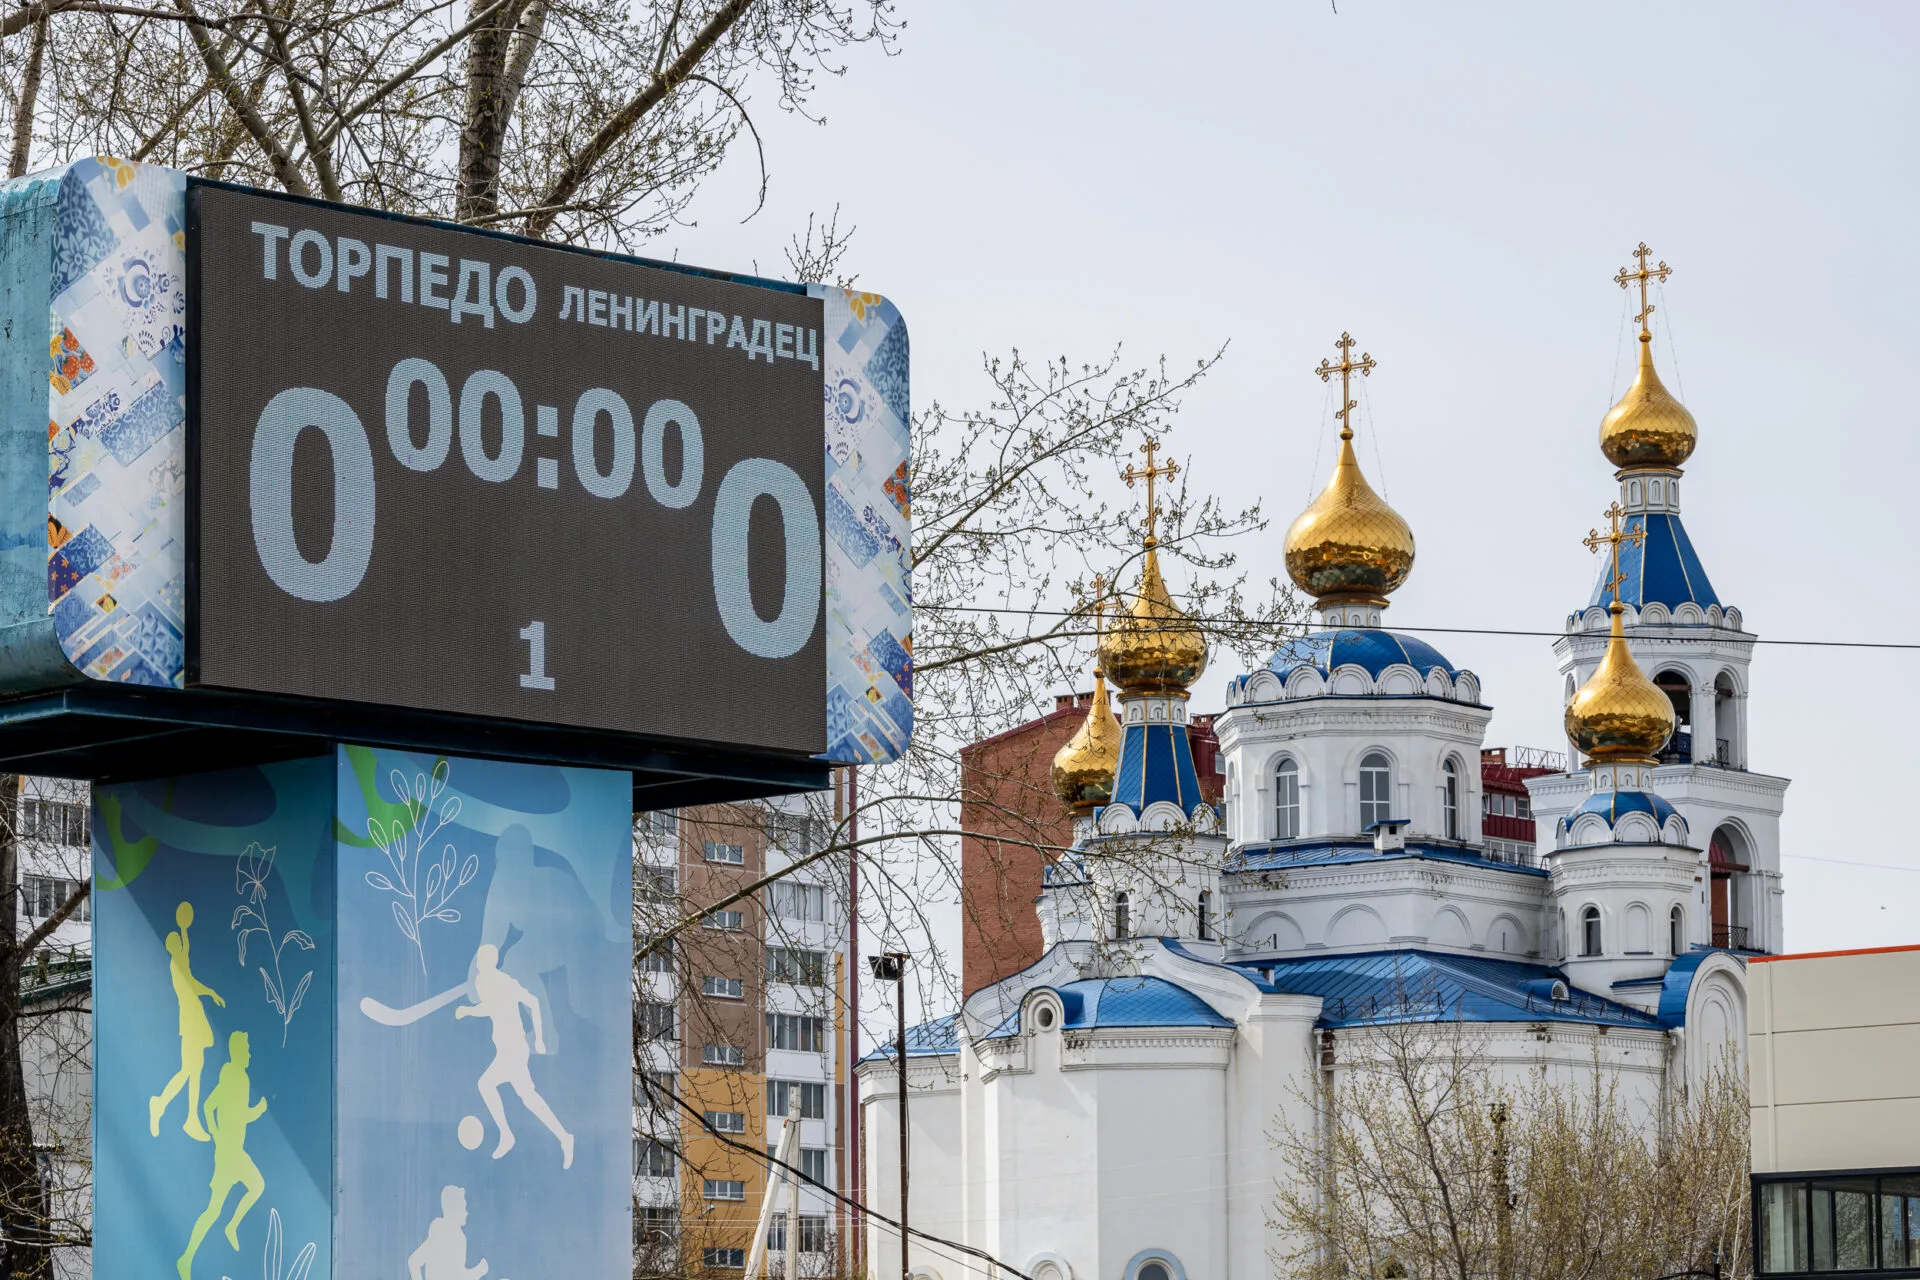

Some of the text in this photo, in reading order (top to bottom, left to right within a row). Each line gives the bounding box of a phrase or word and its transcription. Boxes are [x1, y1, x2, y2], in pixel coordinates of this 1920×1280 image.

[250, 220, 538, 329] ТОРПЕДО
[558, 284, 821, 372] ЛЕНИНГРАДЕЦ
[249, 387, 376, 602] 0
[385, 357, 704, 510] 00:00
[711, 457, 821, 659] 0
[518, 620, 557, 692] 1
